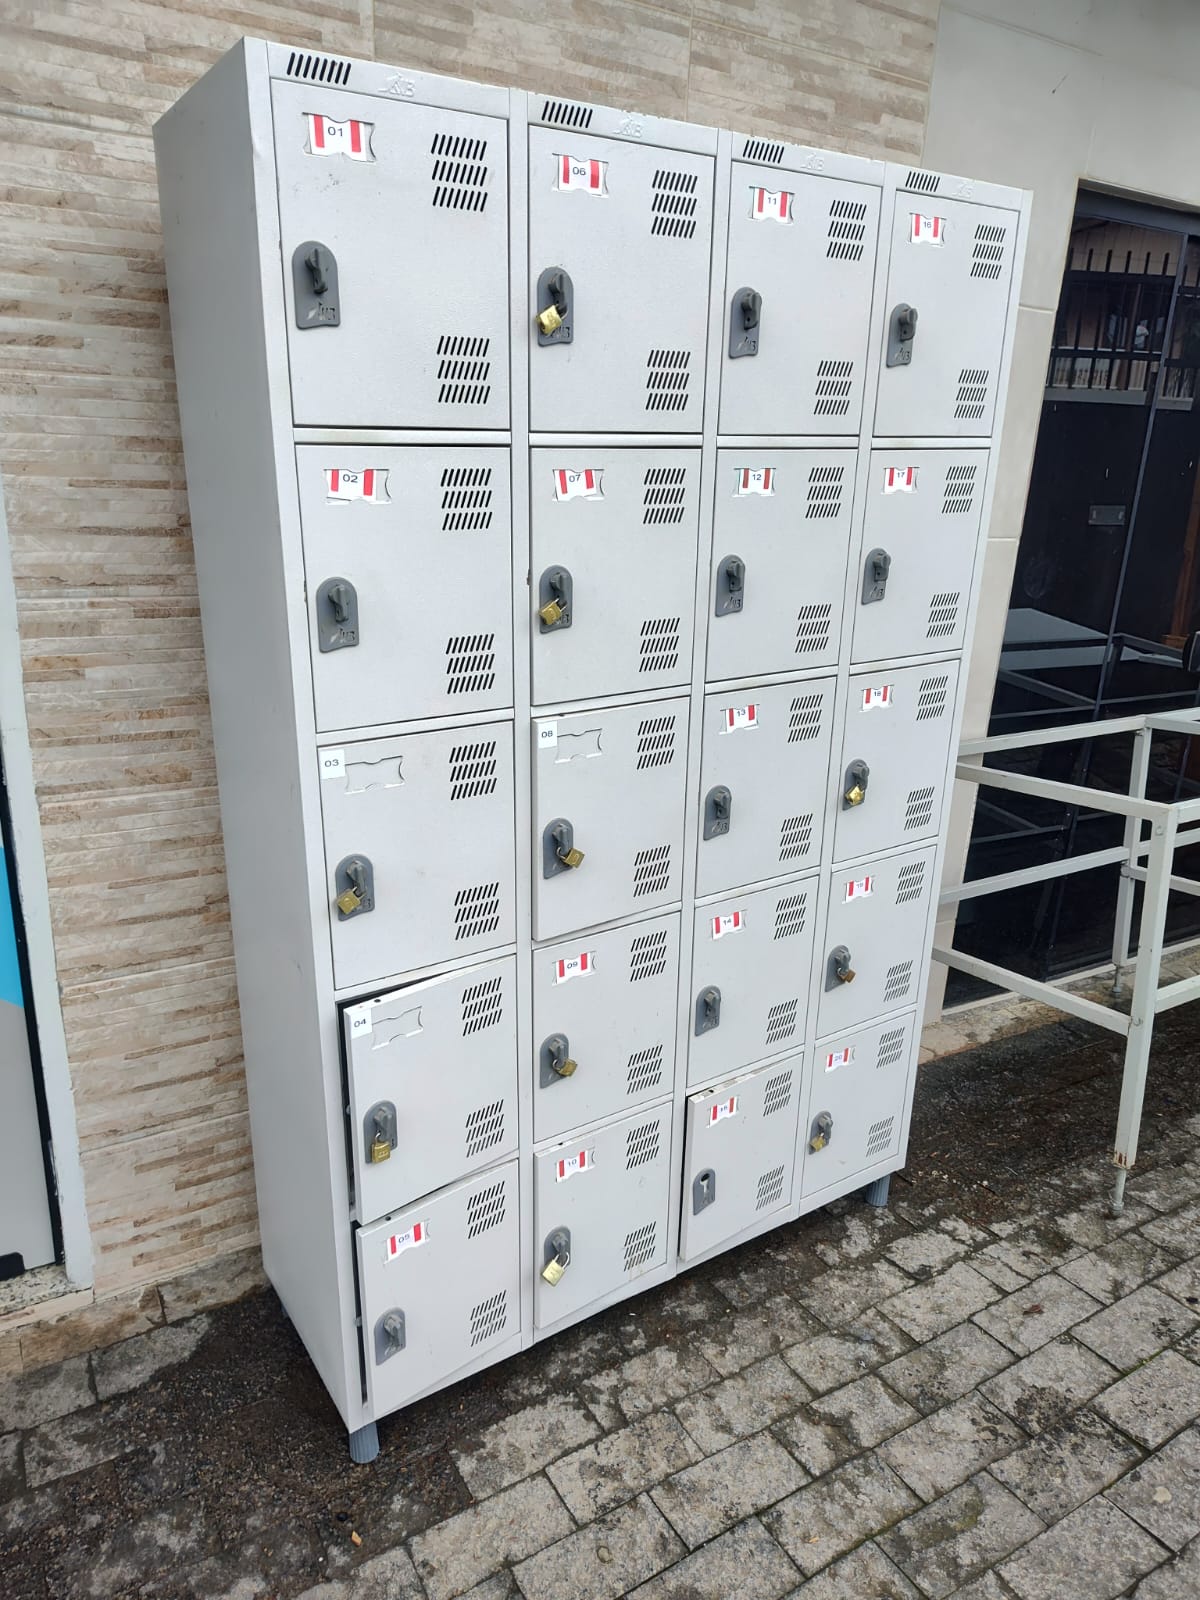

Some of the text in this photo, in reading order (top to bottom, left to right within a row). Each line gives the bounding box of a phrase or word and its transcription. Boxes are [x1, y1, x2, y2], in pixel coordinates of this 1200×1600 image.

[328, 126, 343, 137] 01
[572, 166, 586, 176] 06
[767, 197, 777, 205] 11
[342, 474, 358, 483] 02
[569, 473, 581, 483] 07
[752, 473, 762, 481] 12
[737, 709, 746, 717] 13
[541, 730, 553, 738] 08
[324, 758, 339, 768] 03
[723, 918, 732, 926] 14
[566, 961, 578, 969] 09
[354, 1018, 367, 1028] 04
[568, 1159, 577, 1167] 10
